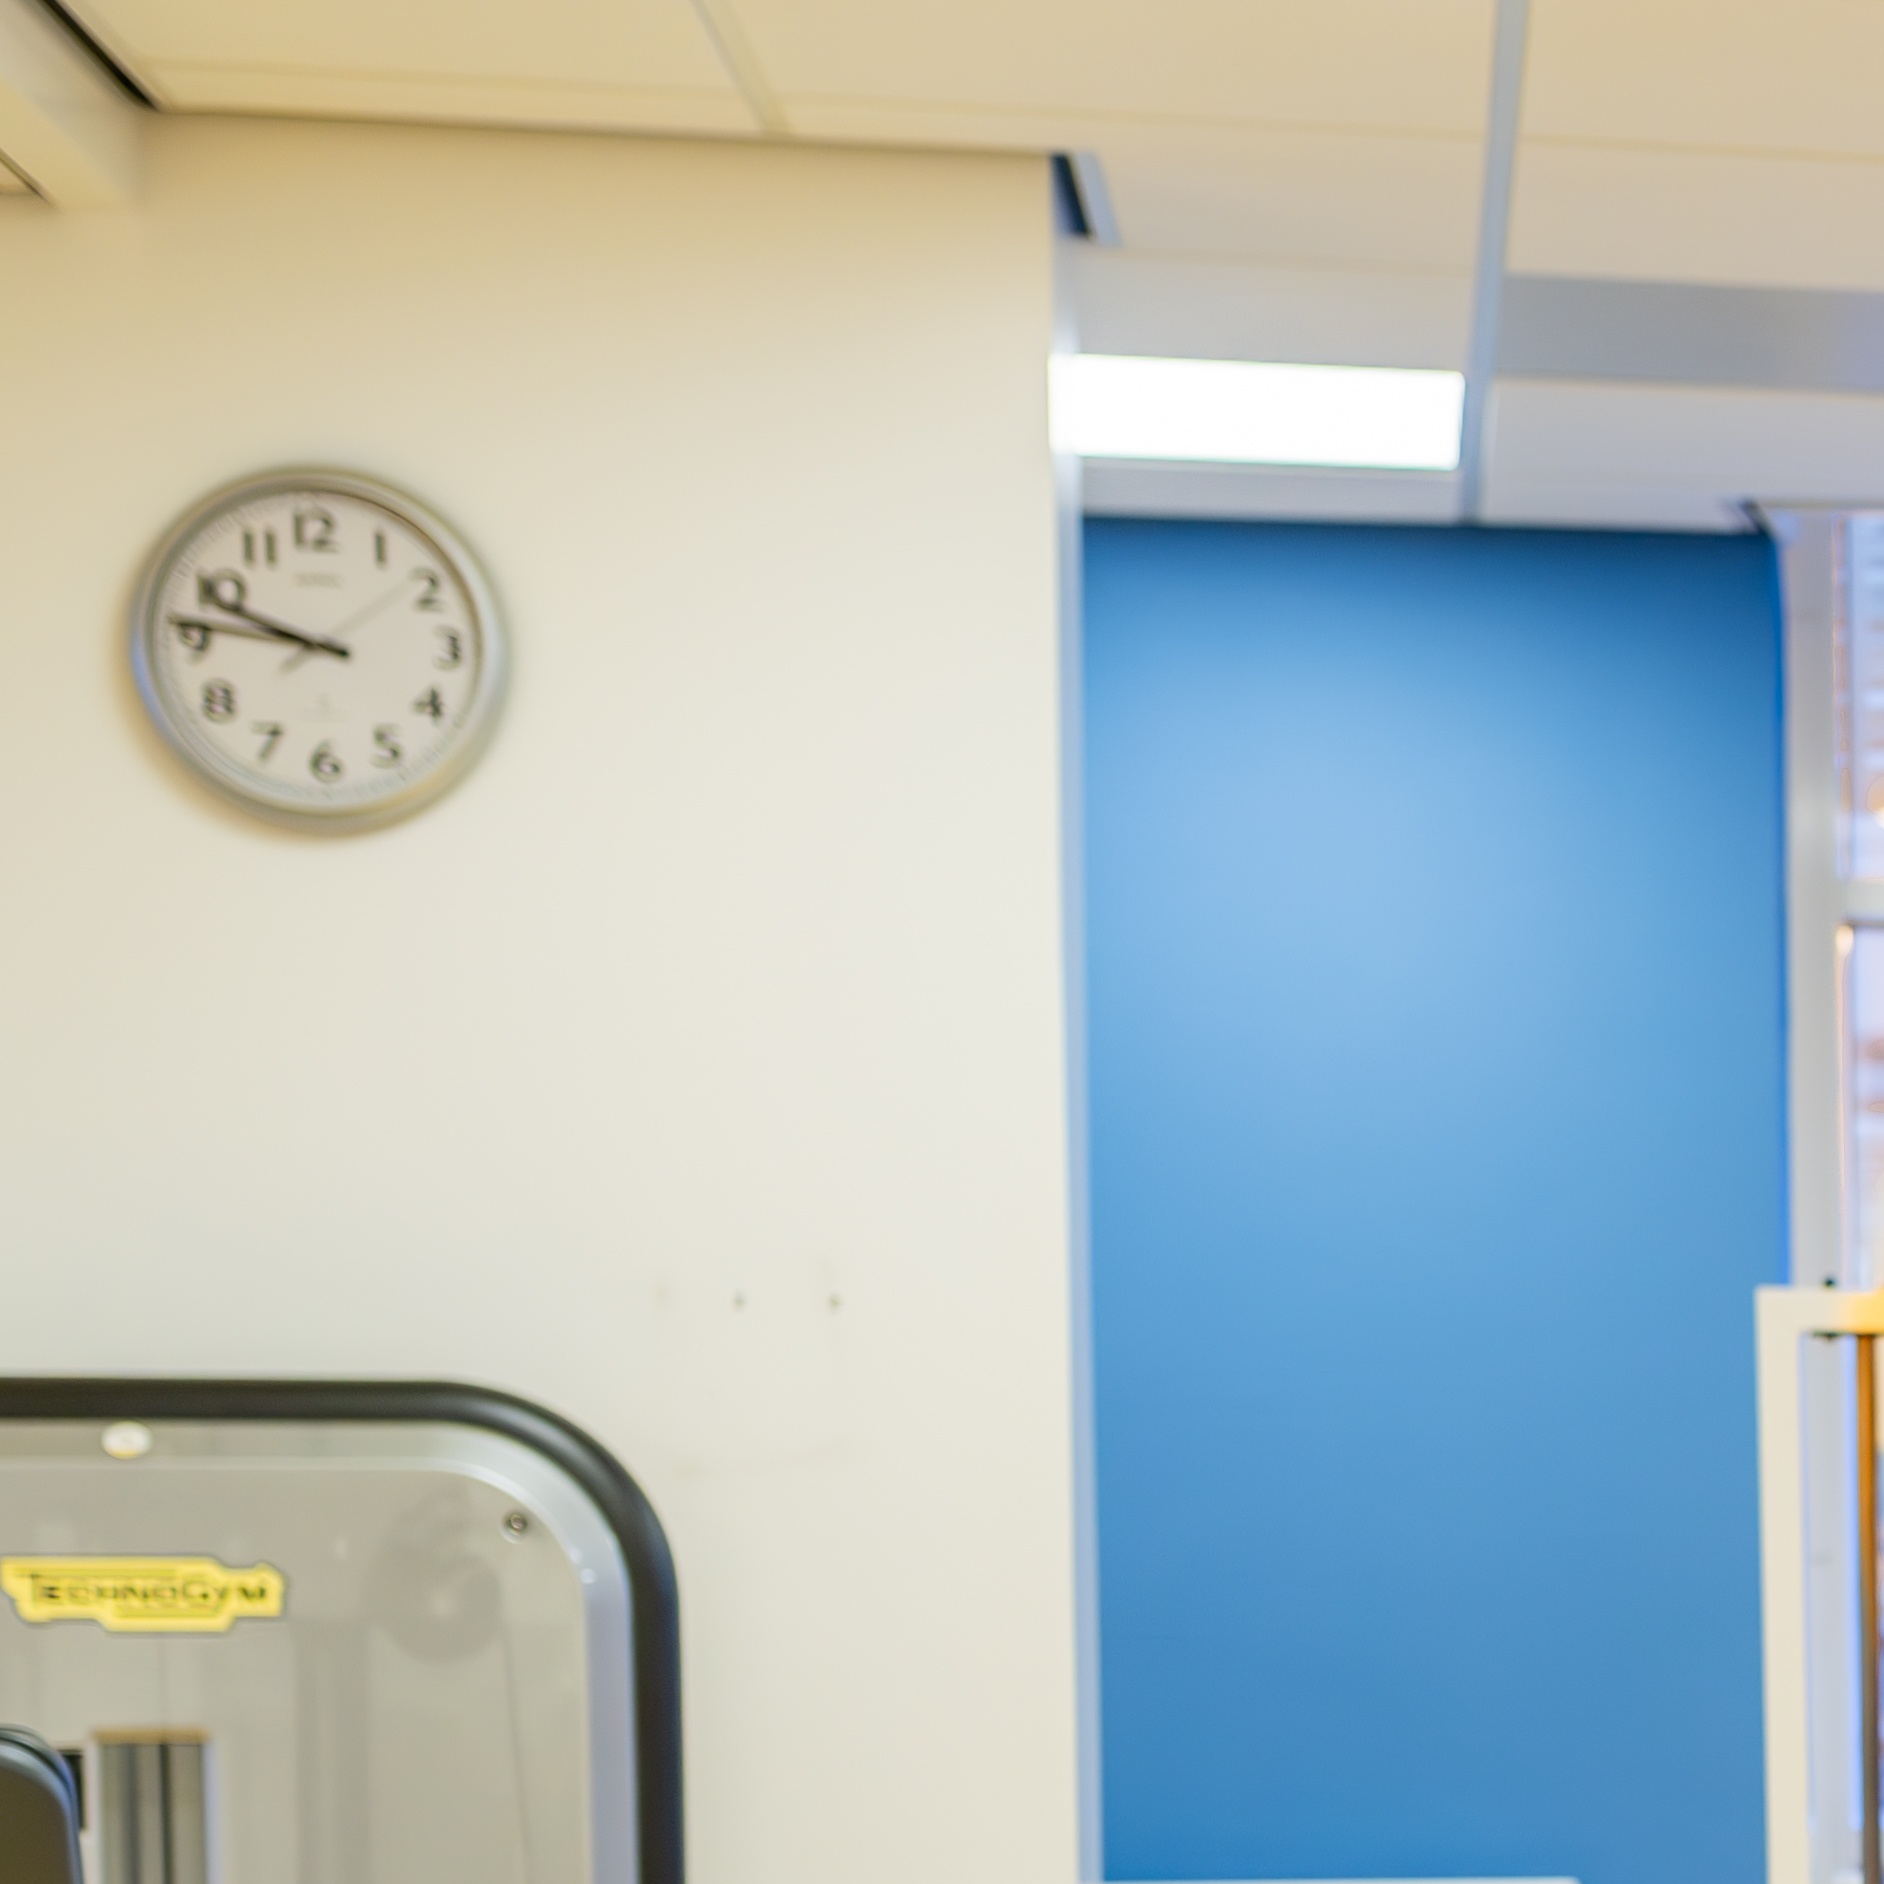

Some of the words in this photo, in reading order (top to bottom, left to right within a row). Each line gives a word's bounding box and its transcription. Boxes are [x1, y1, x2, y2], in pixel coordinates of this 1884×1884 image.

[243, 529, 277, 567] 11
[294, 507, 338, 552] 12
[374, 530, 386, 567] 1
[409, 568, 441, 610] 2
[434, 627, 463, 670] 3
[202, 678, 236, 724] 8
[412, 687, 445, 722] 4
[252, 721, 284, 764] 7
[310, 741, 343, 783] 6
[372, 725, 403, 767] 5
